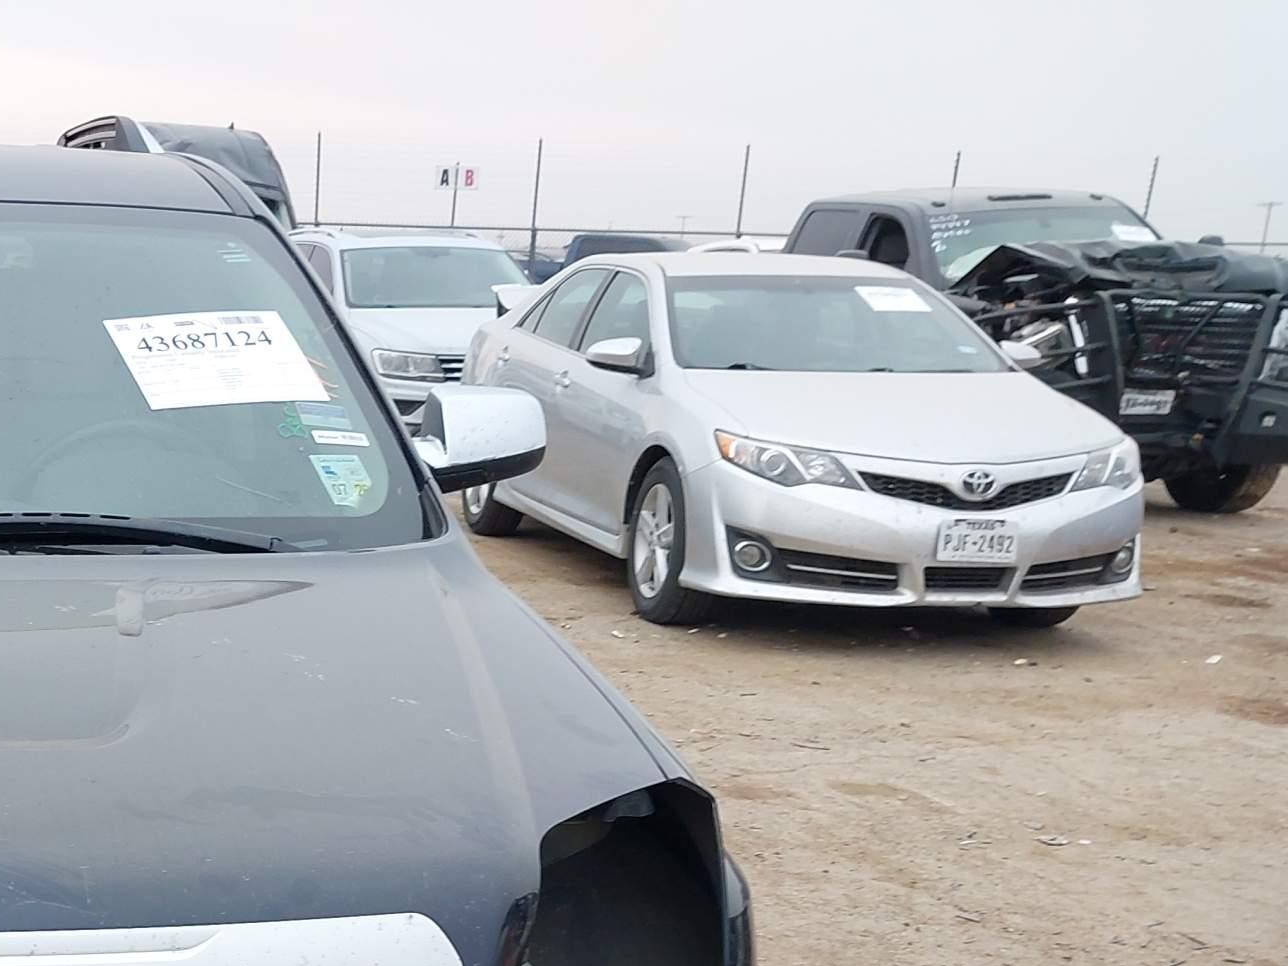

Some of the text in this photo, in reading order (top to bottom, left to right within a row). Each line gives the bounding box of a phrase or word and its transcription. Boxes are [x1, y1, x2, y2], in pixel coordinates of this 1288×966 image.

[440, 169, 474, 187] A B
[137, 330, 272, 353] 43687124
[943, 533, 1015, 554] PJF-2492
